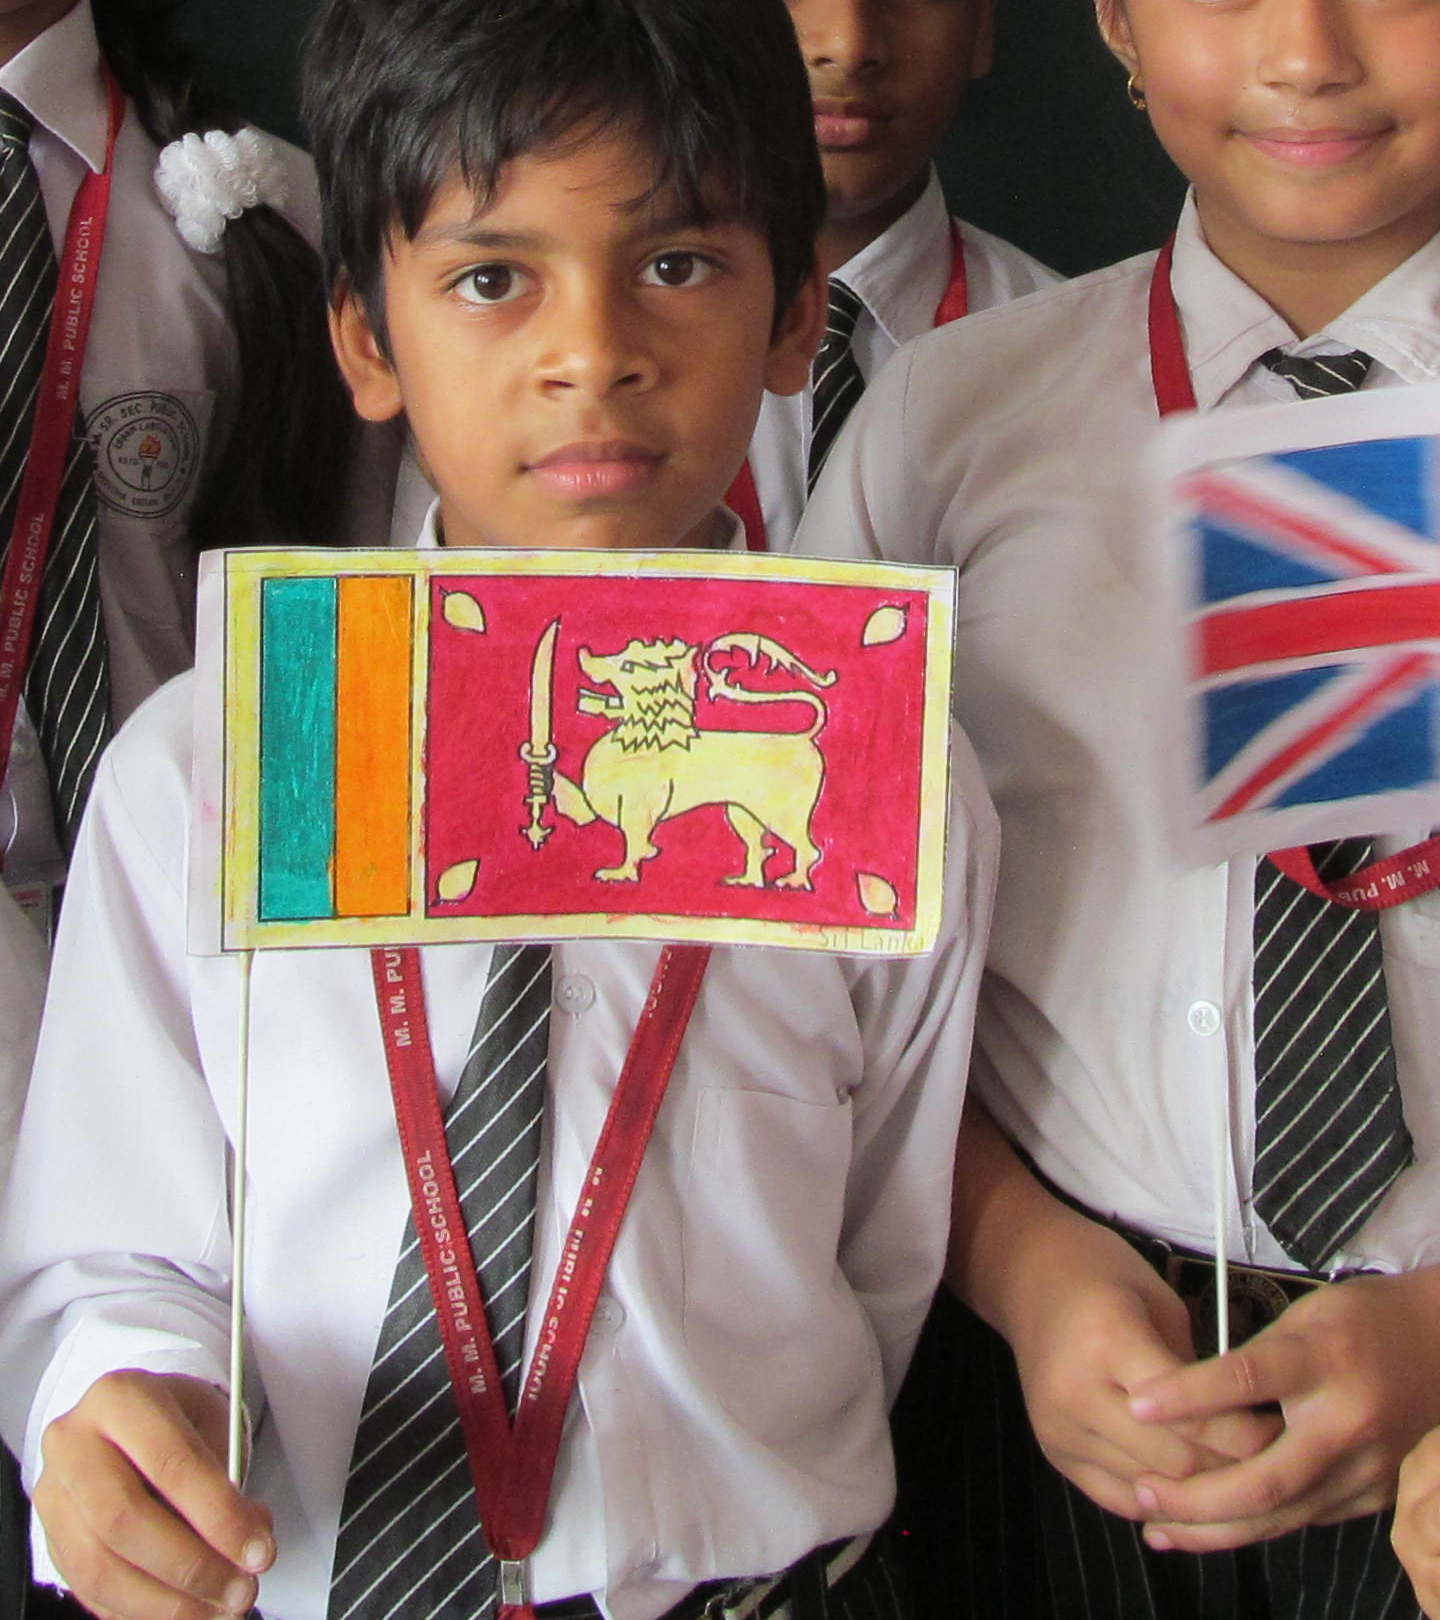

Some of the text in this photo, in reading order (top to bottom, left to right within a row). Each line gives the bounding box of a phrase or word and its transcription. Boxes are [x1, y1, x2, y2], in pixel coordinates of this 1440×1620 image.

[72, 216, 94, 284] SCHOOL
[63, 286, 84, 351] PUBLIC
[4, 589, 29, 653] PUBLIC
[19, 512, 45, 584] SCHOOL
[1380, 870, 1407, 891] M.
[1407, 860, 1431, 879] M.
[862, 929, 926, 953] Lanka
[389, 987, 408, 1016] M.
[394, 1020, 413, 1048] M.
[416, 1149, 488, 1394] M. M. PUBLIC SCHOOL
